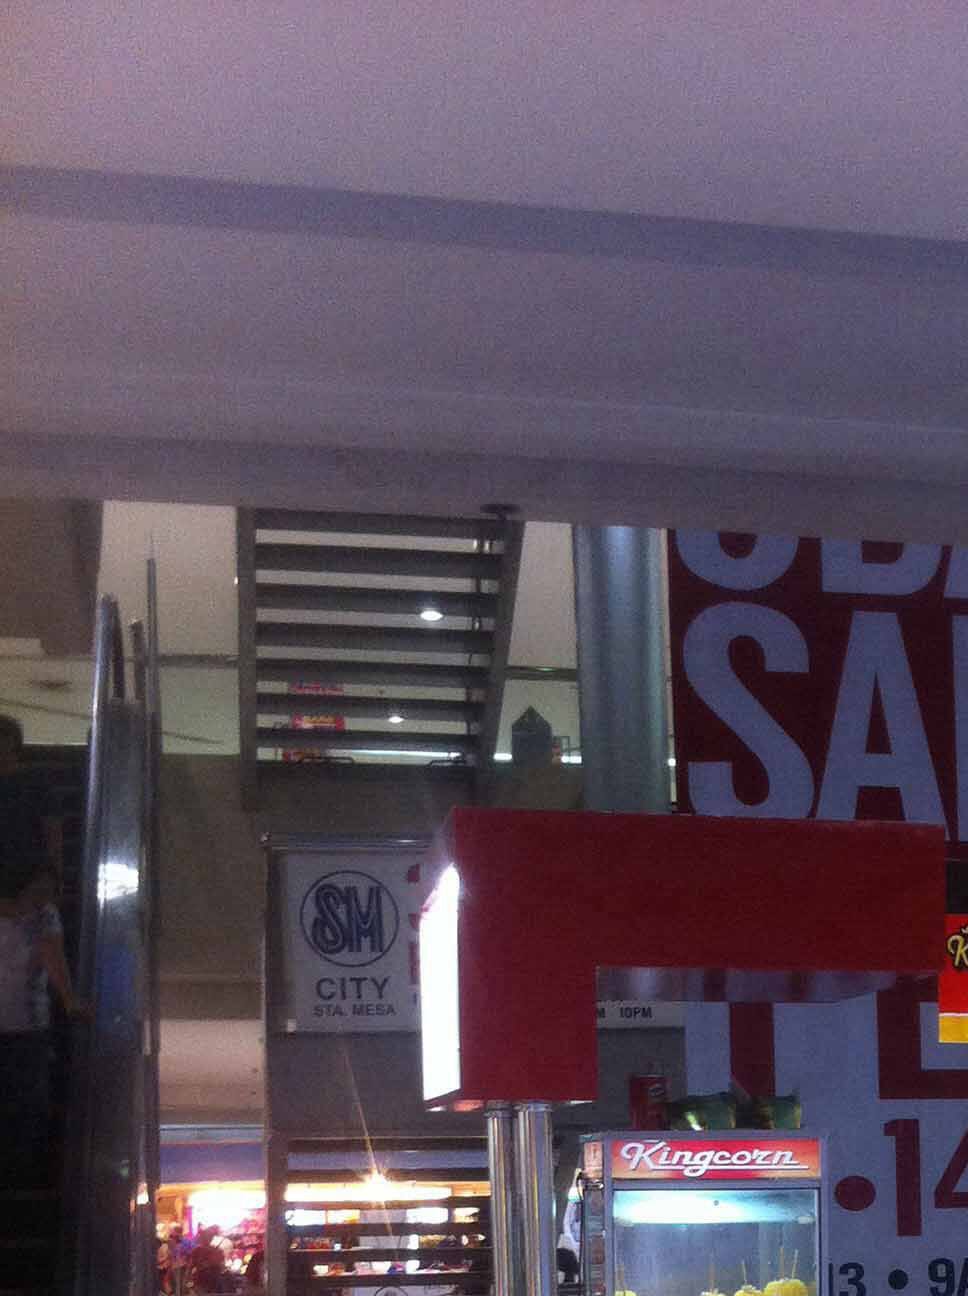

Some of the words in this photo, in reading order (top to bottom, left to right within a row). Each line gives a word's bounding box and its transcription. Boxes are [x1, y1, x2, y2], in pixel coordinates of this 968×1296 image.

[312, 883, 385, 954] SM
[315, 976, 391, 1001] CITY
[313, 1003, 347, 1017] STA.
[352, 1003, 397, 1016] MESA
[620, 1139, 809, 1177] Kingcorn
